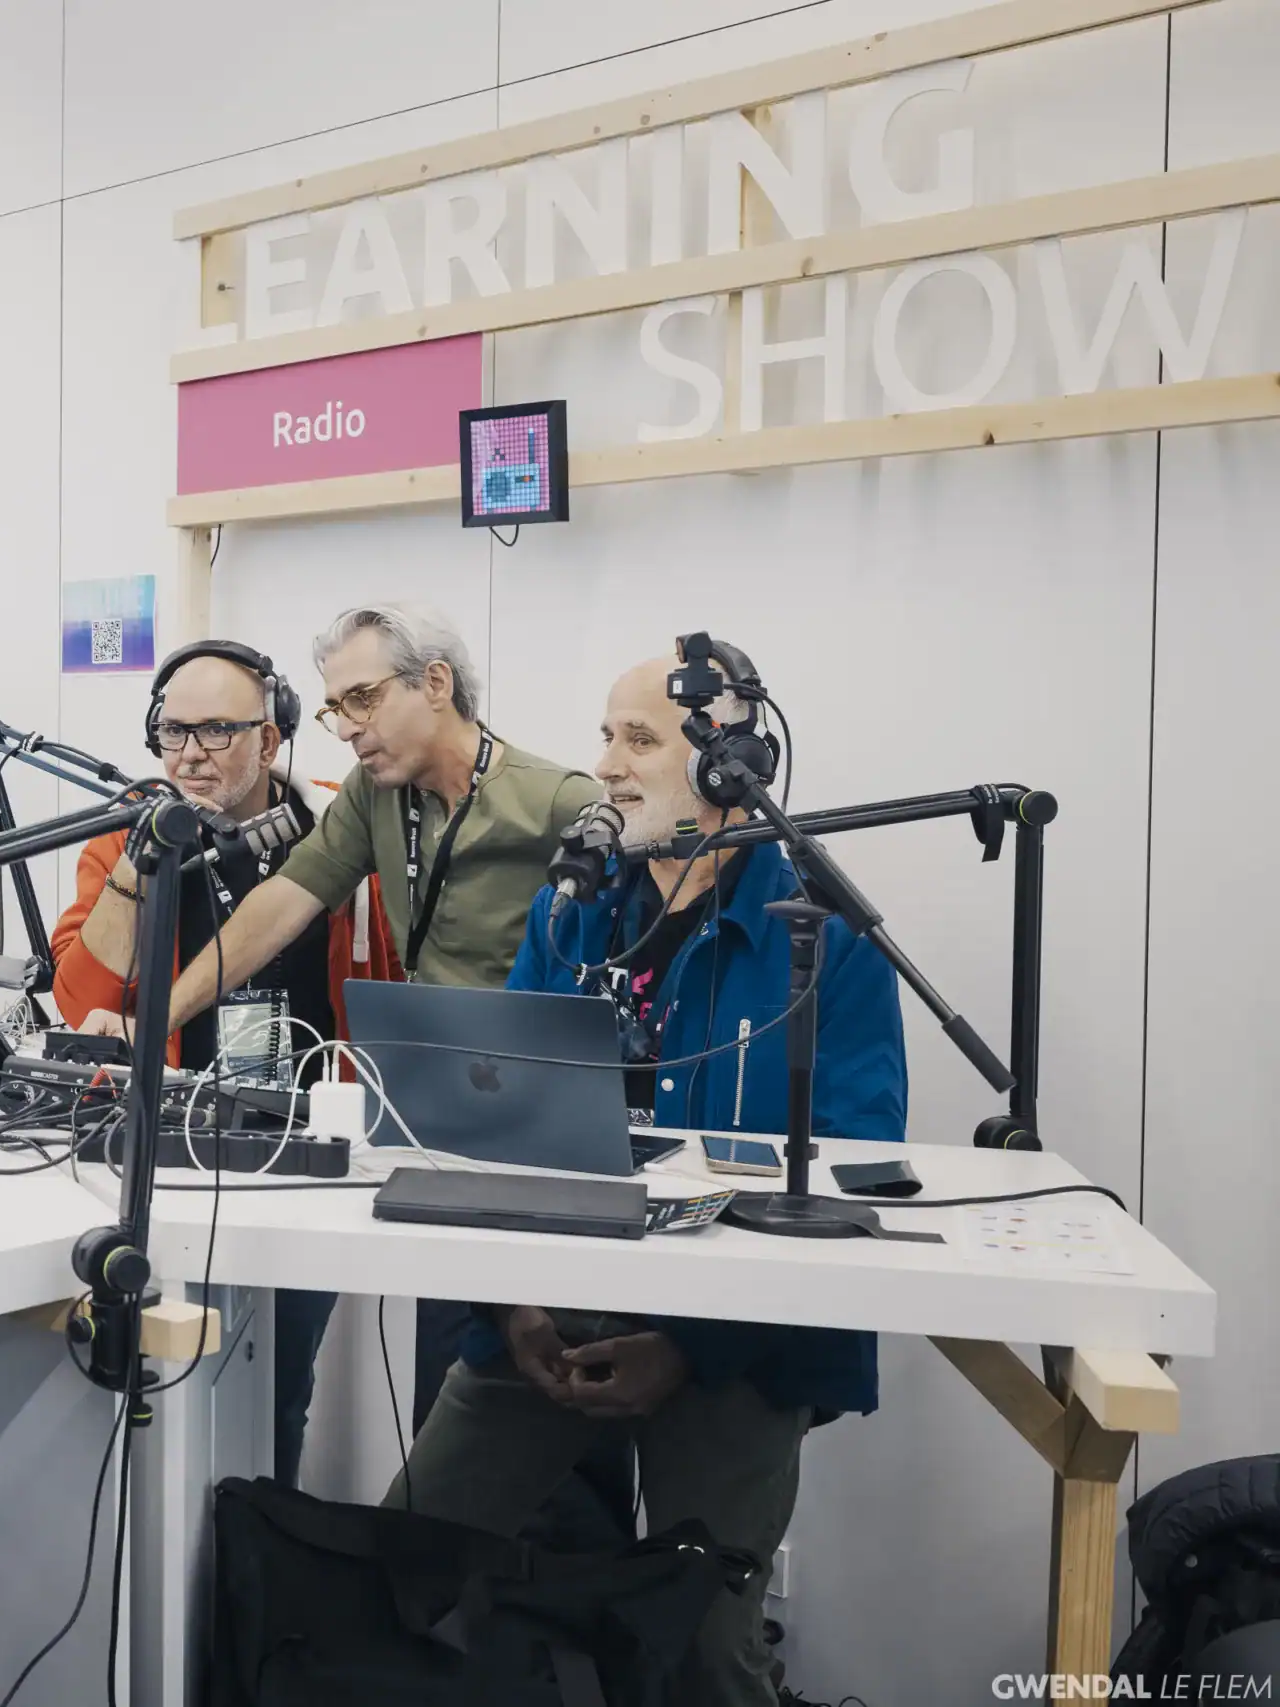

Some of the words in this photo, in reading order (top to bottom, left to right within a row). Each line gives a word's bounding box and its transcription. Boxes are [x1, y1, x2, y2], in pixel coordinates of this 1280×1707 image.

[174, 58, 976, 350] LEARNING
[272, 401, 365, 448] Radio
[637, 206, 1250, 444] SHOW
